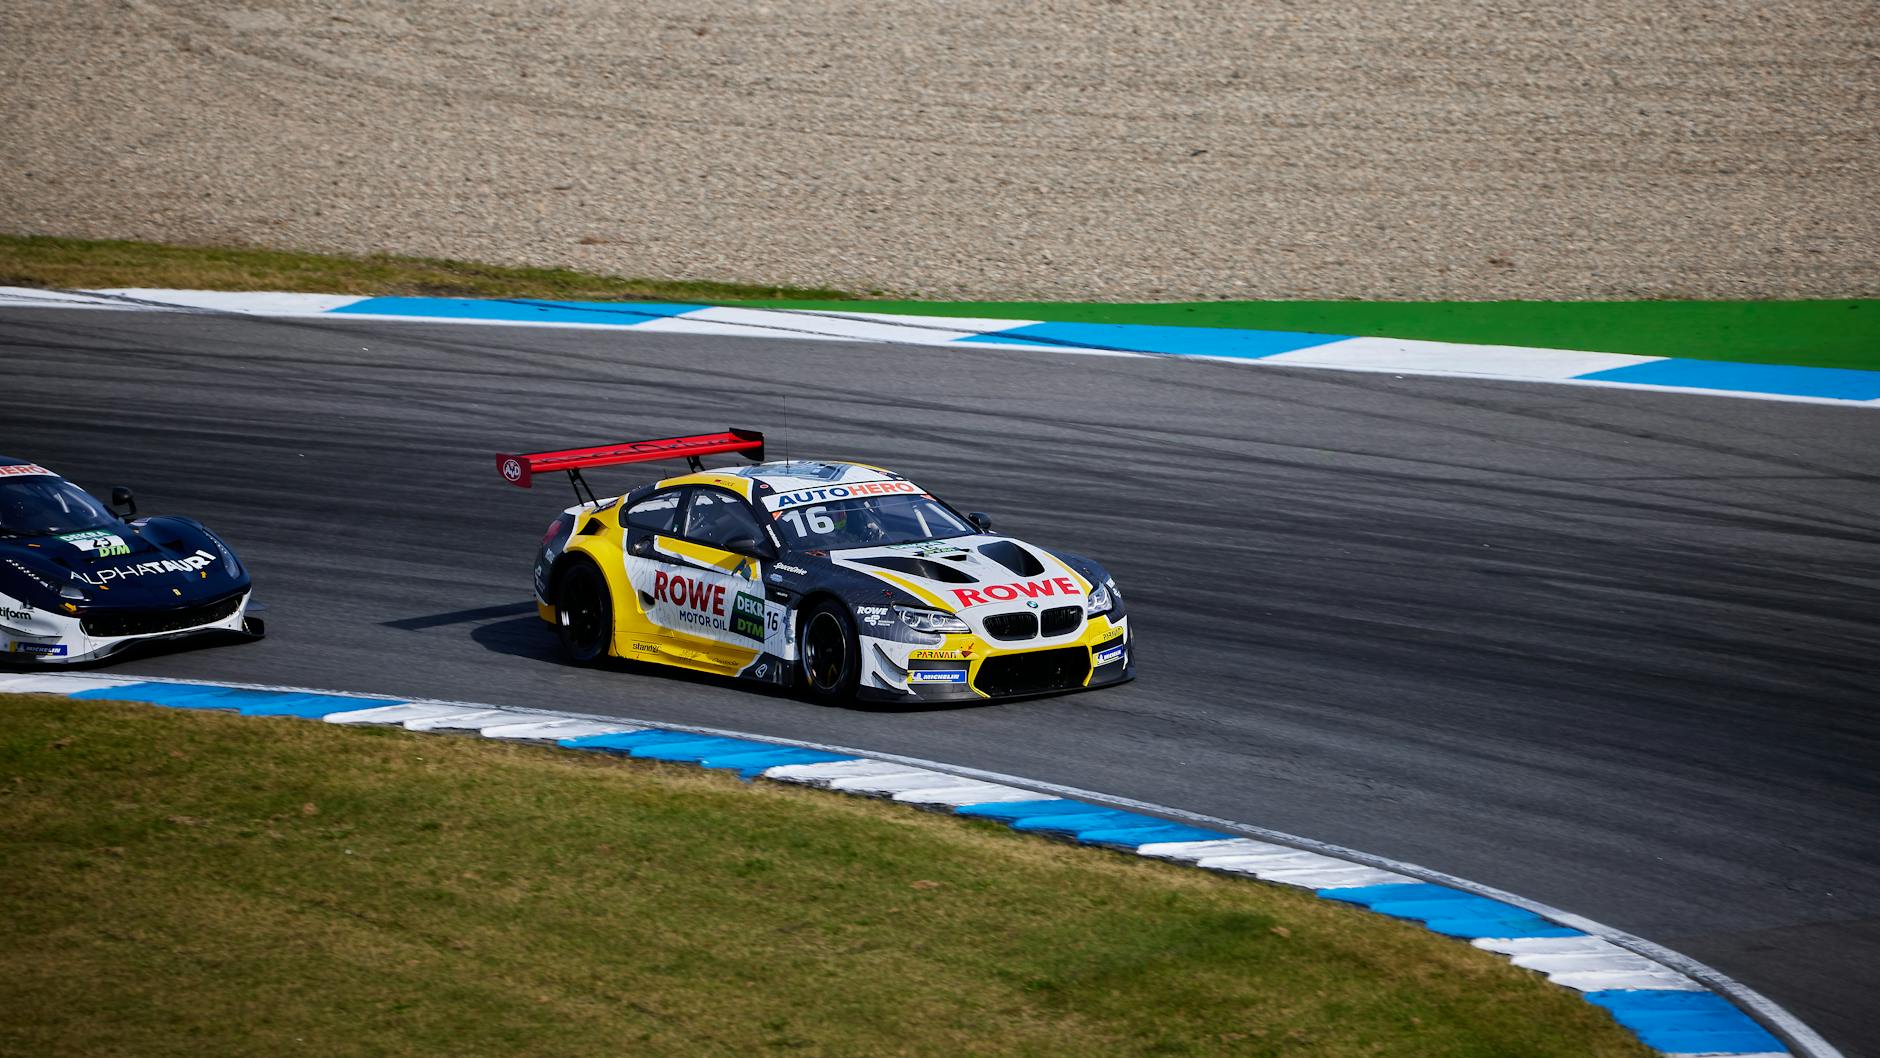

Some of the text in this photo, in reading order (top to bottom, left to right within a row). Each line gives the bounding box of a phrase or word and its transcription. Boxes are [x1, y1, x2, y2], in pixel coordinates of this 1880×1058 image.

[778, 483, 914, 508] AUTOHERO
[782, 506, 835, 538] 16
[60, 531, 111, 542] DEKRA
[99, 545, 131, 557] DTM
[70, 550, 216, 585] ALPHATAURI
[653, 569, 726, 617] ROWE
[951, 577, 1081, 608] ROWE
[680, 610, 727, 631] MOTOR OIL
[766, 611, 779, 631] 16
[857, 606, 888, 616] ROWE
[737, 618, 764, 637] DTM
[916, 650, 957, 659] PARAVAN
